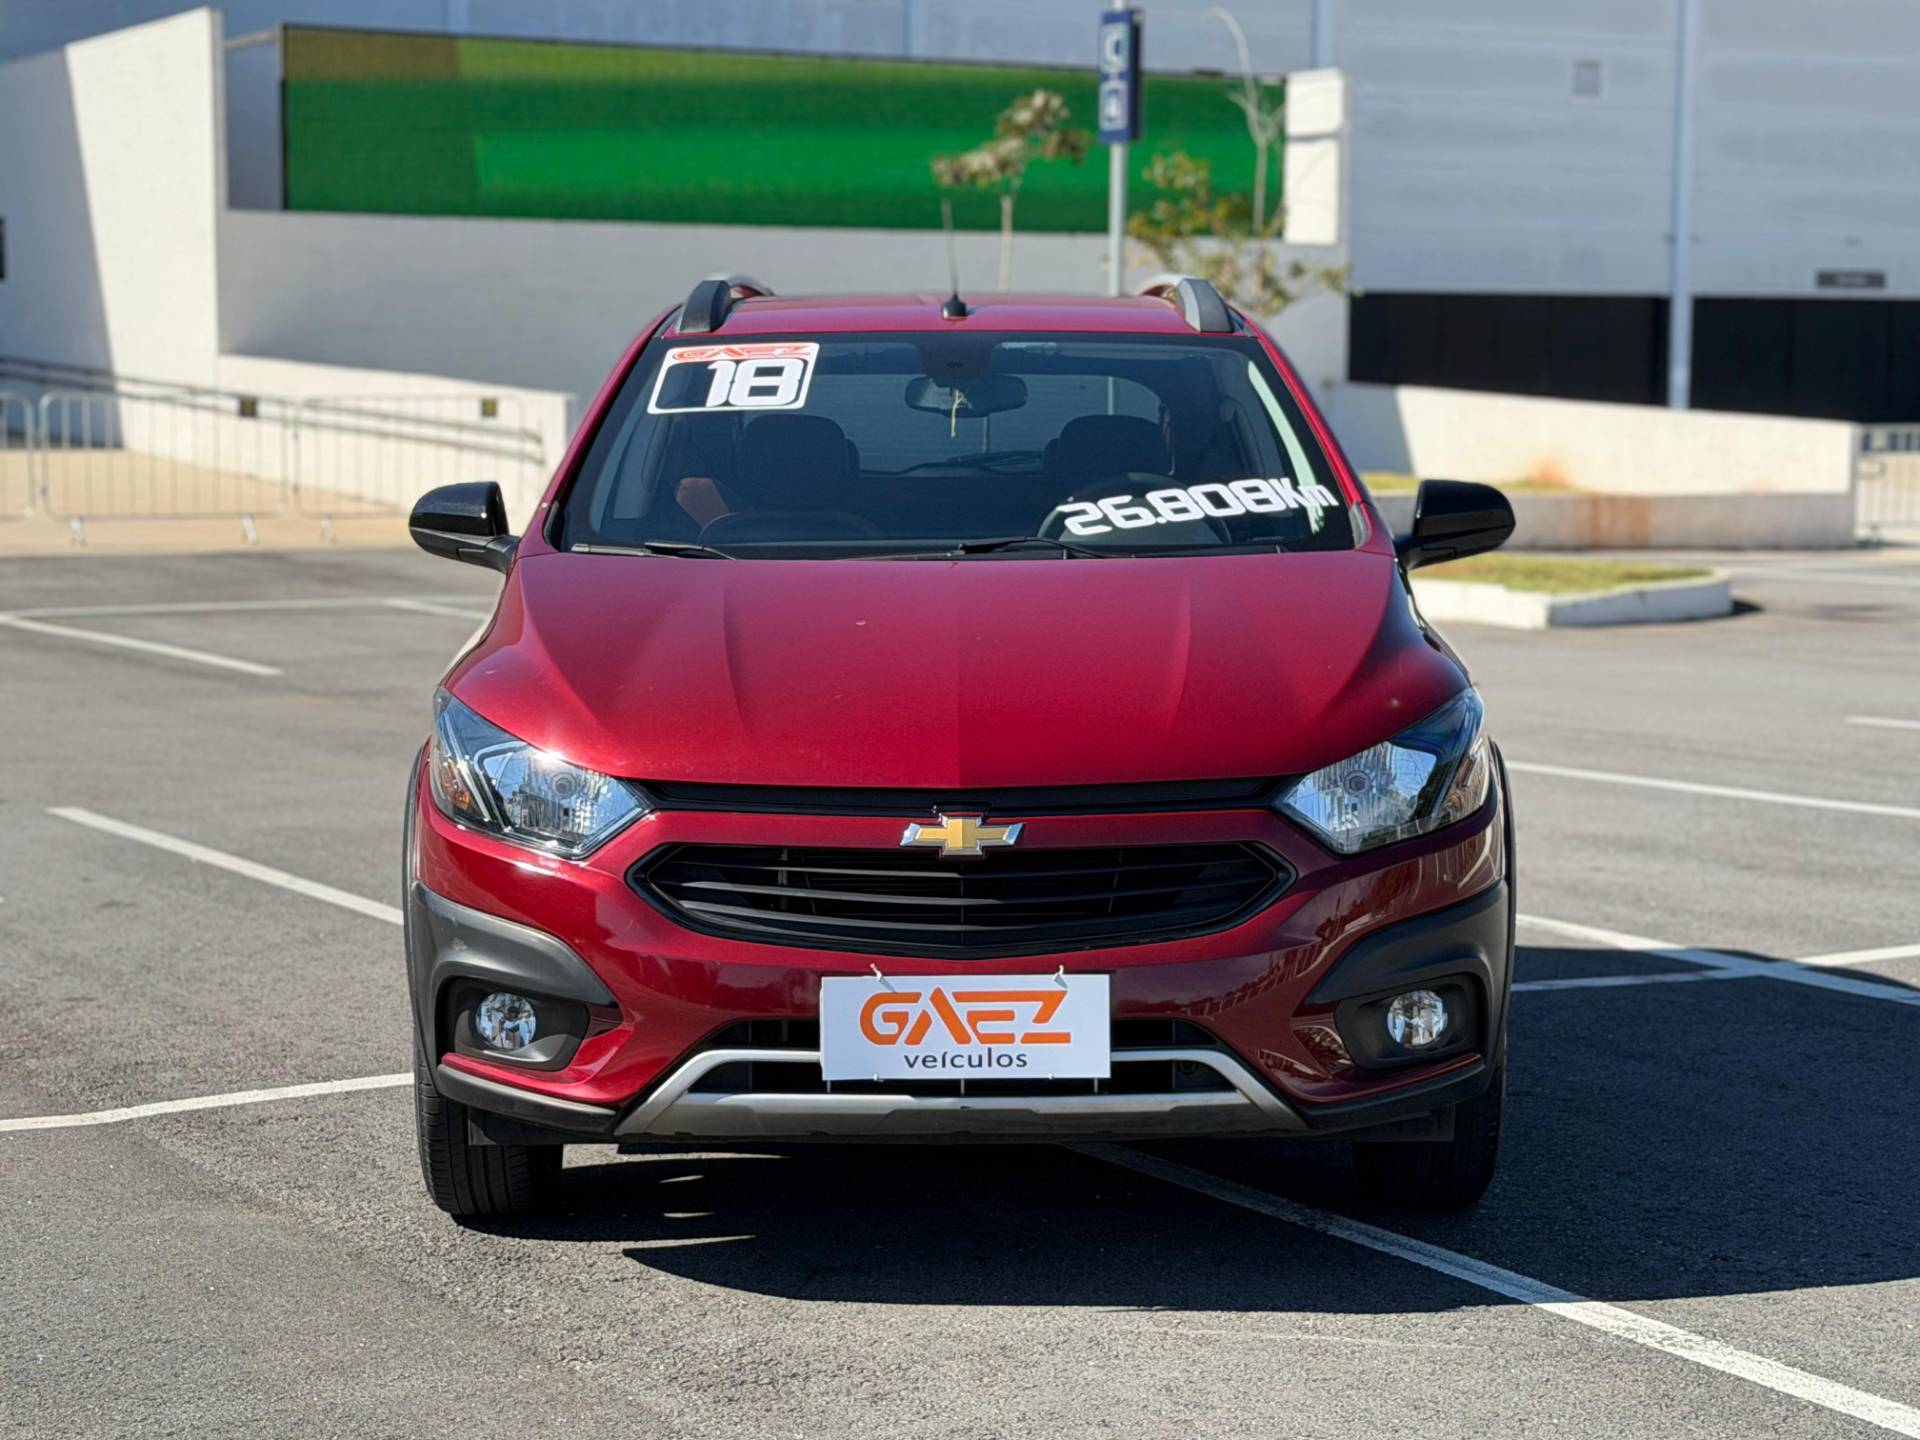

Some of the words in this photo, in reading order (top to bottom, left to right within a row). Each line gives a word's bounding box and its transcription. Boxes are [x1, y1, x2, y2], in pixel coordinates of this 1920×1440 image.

[705, 357, 805, 408] 18
[859, 986, 1072, 1046] GAEZ
[903, 1047, 1028, 1069] veículos
